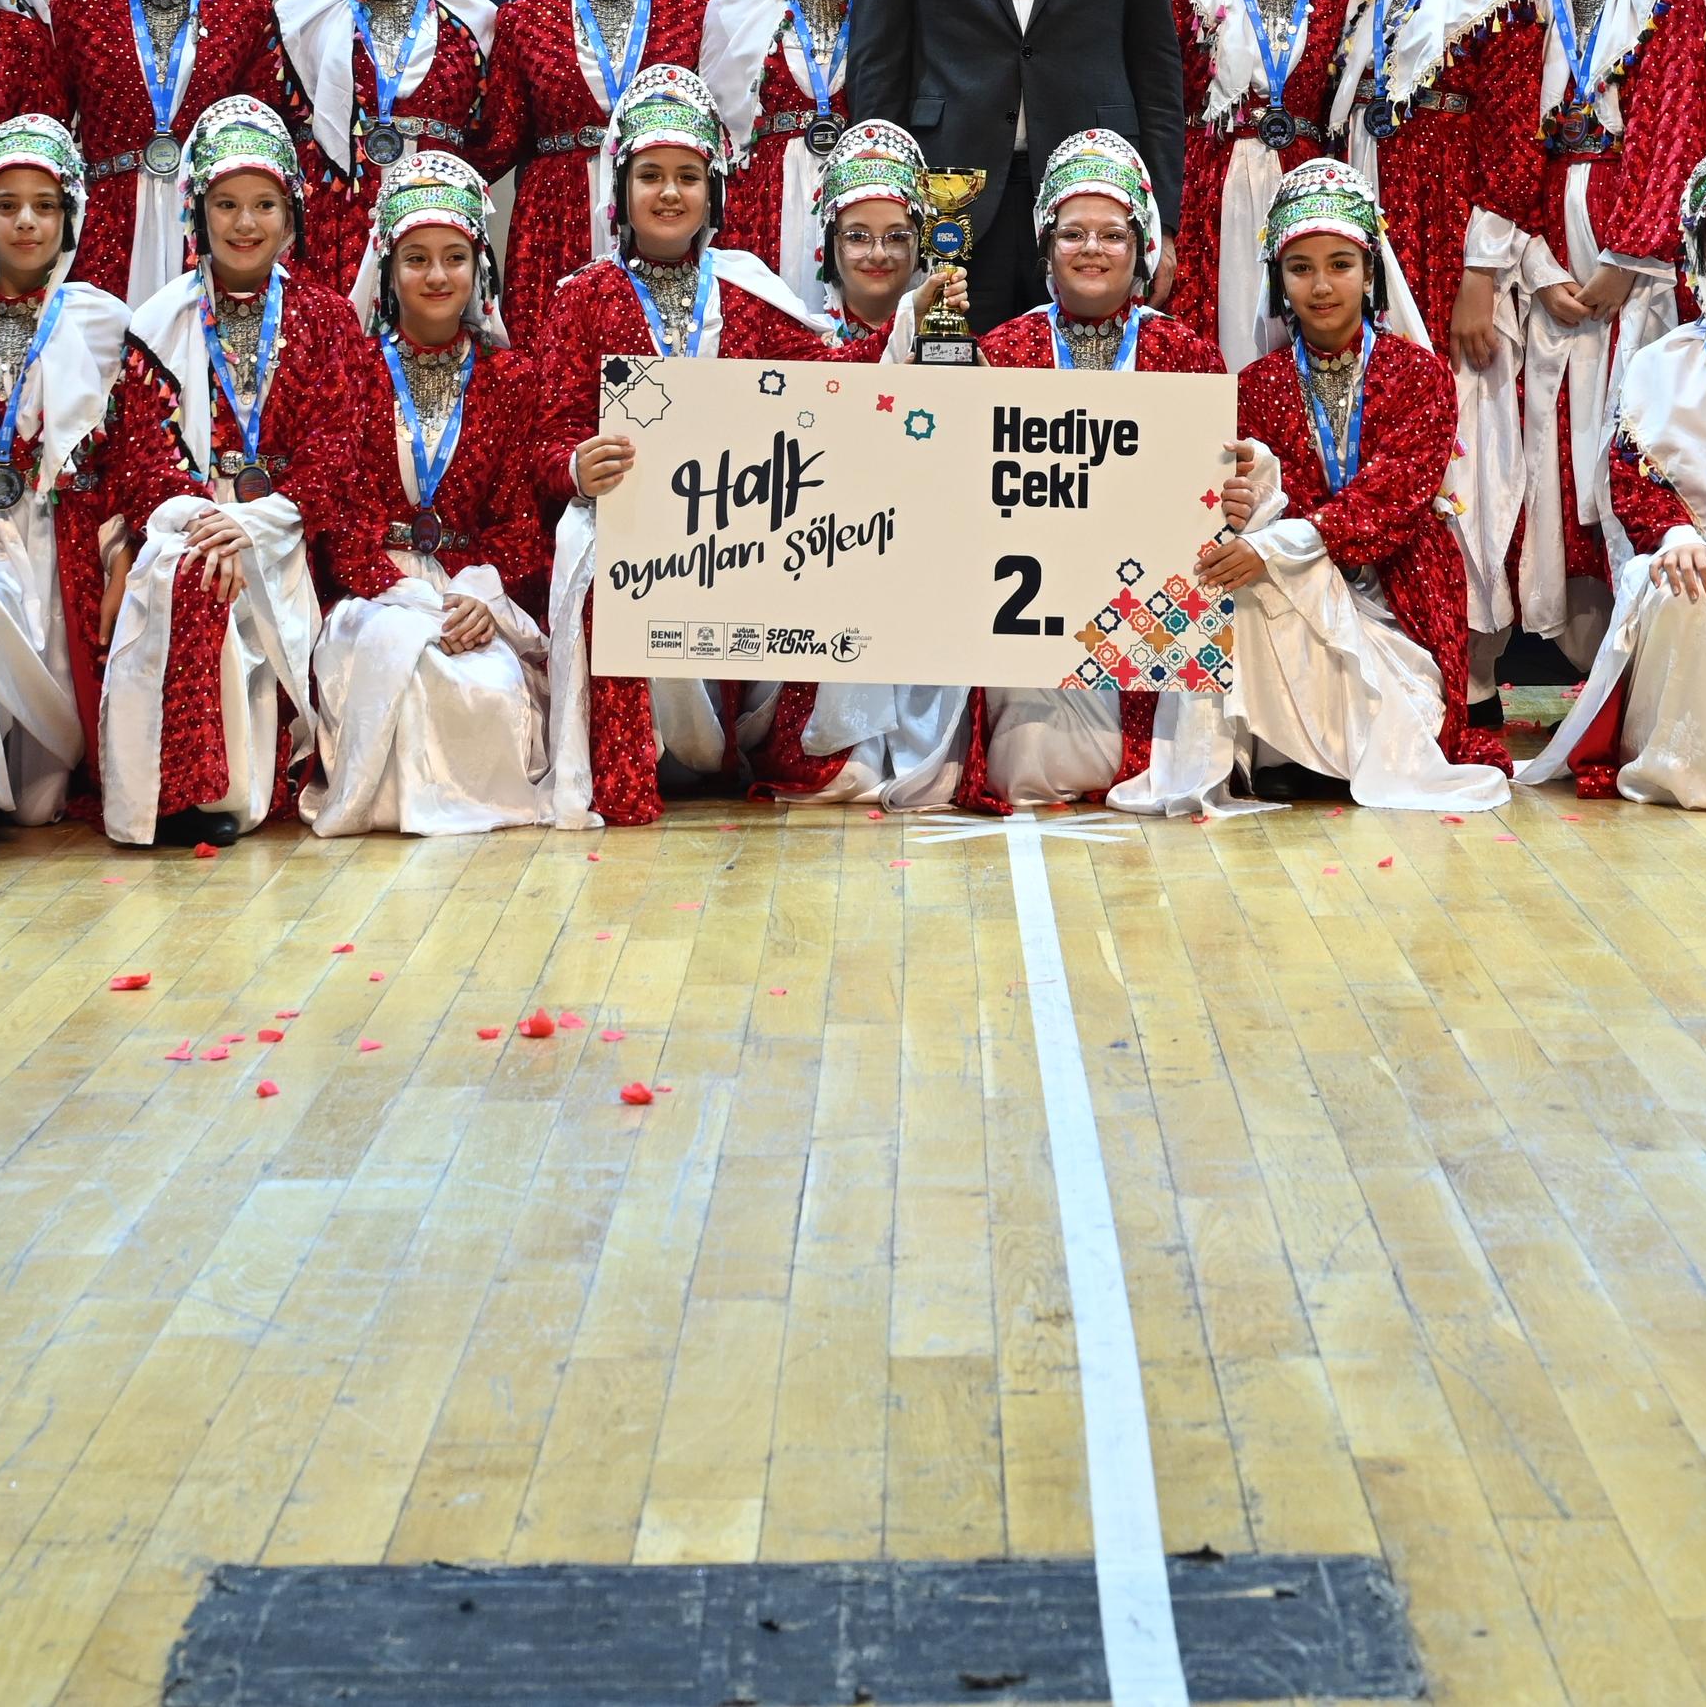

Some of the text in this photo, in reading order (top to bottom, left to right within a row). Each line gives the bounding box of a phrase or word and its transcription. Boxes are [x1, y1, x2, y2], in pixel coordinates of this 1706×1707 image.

[993, 406, 1138, 466] Hediye
[671, 430, 825, 535] Halk
[992, 460, 1089, 518] Çeki
[993, 555, 1064, 636] 2.
[728, 638, 761, 655] Altay
[766, 628, 815, 643] SPOR
[767, 638, 827, 654] KONYA
